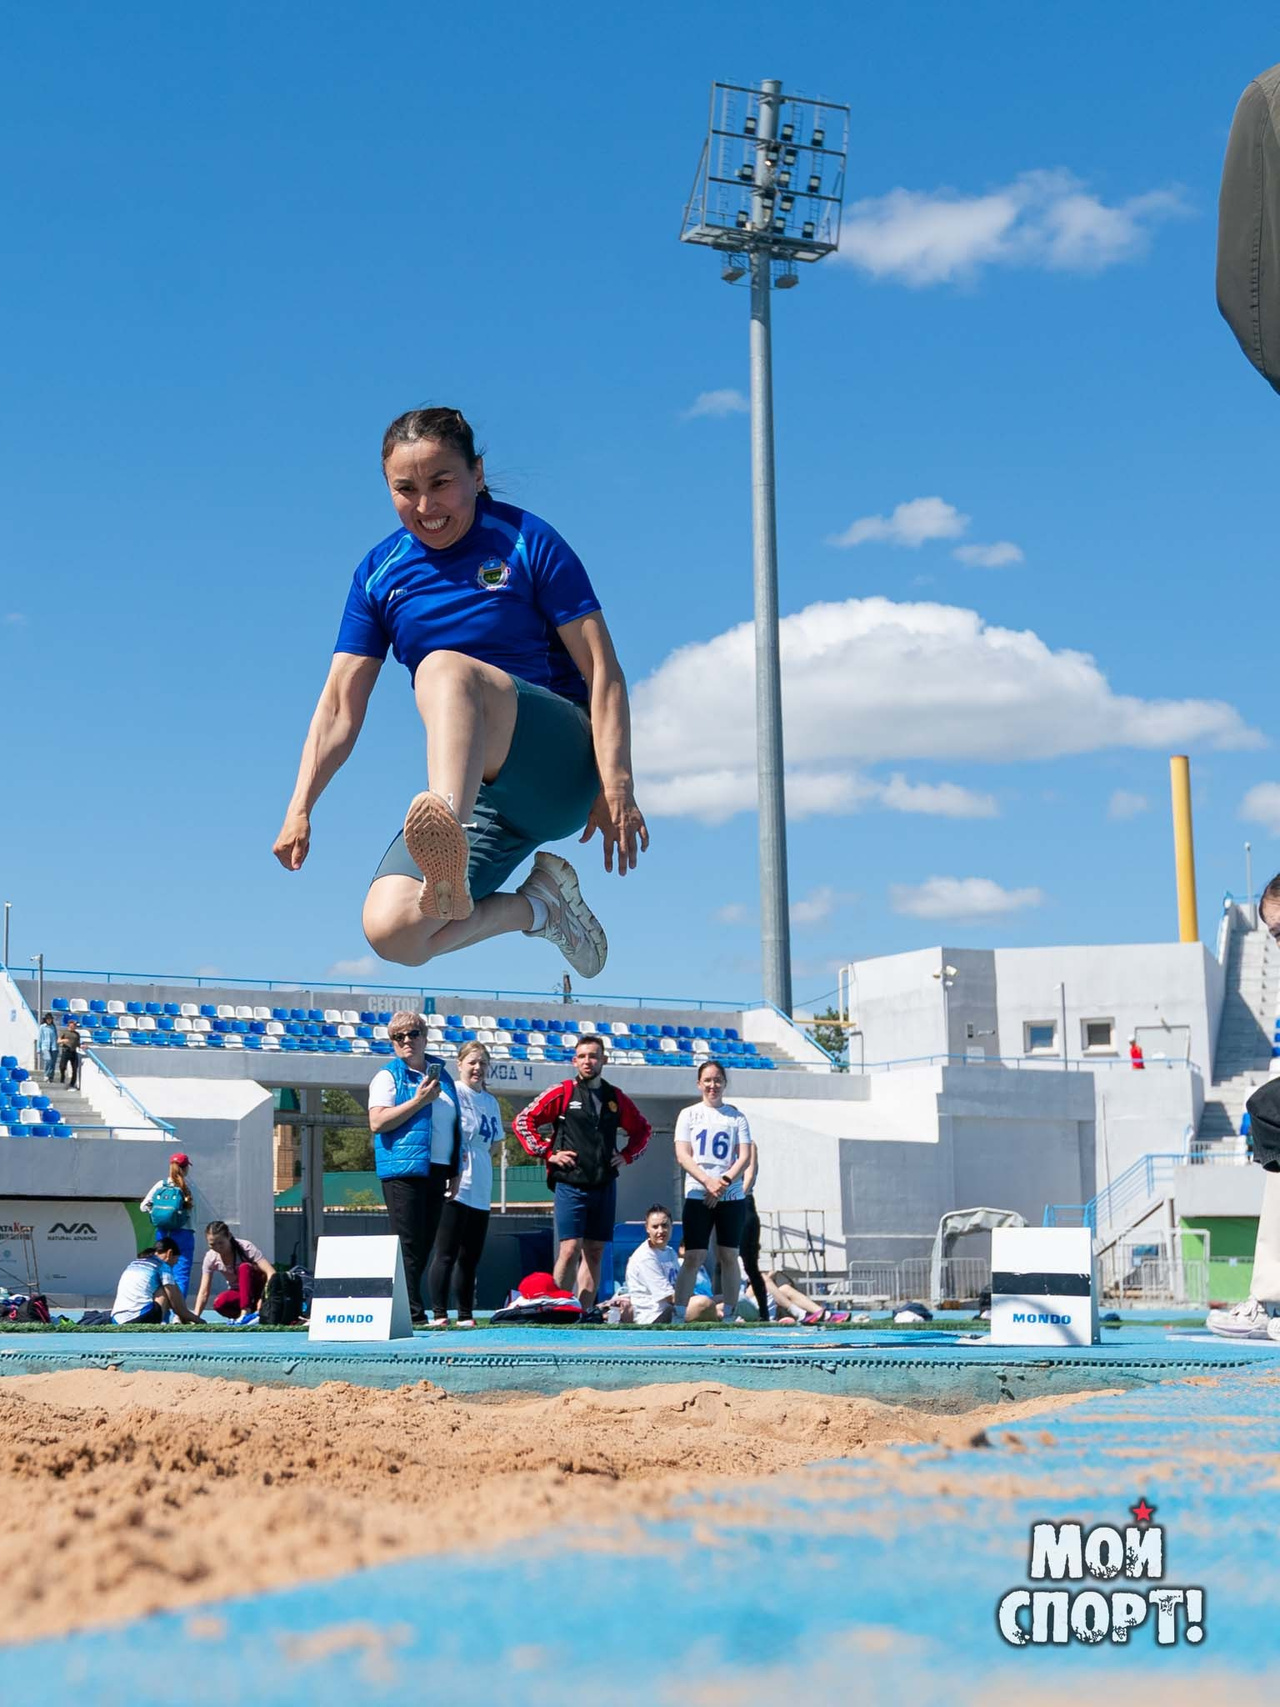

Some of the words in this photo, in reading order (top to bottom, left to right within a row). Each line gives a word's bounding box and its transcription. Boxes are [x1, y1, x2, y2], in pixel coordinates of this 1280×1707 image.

[486, 1064, 518, 1080] ХОД
[695, 1128, 730, 1160] 16
[325, 1314, 374, 1324] MONDO
[1012, 1313, 1072, 1325] MONDO
